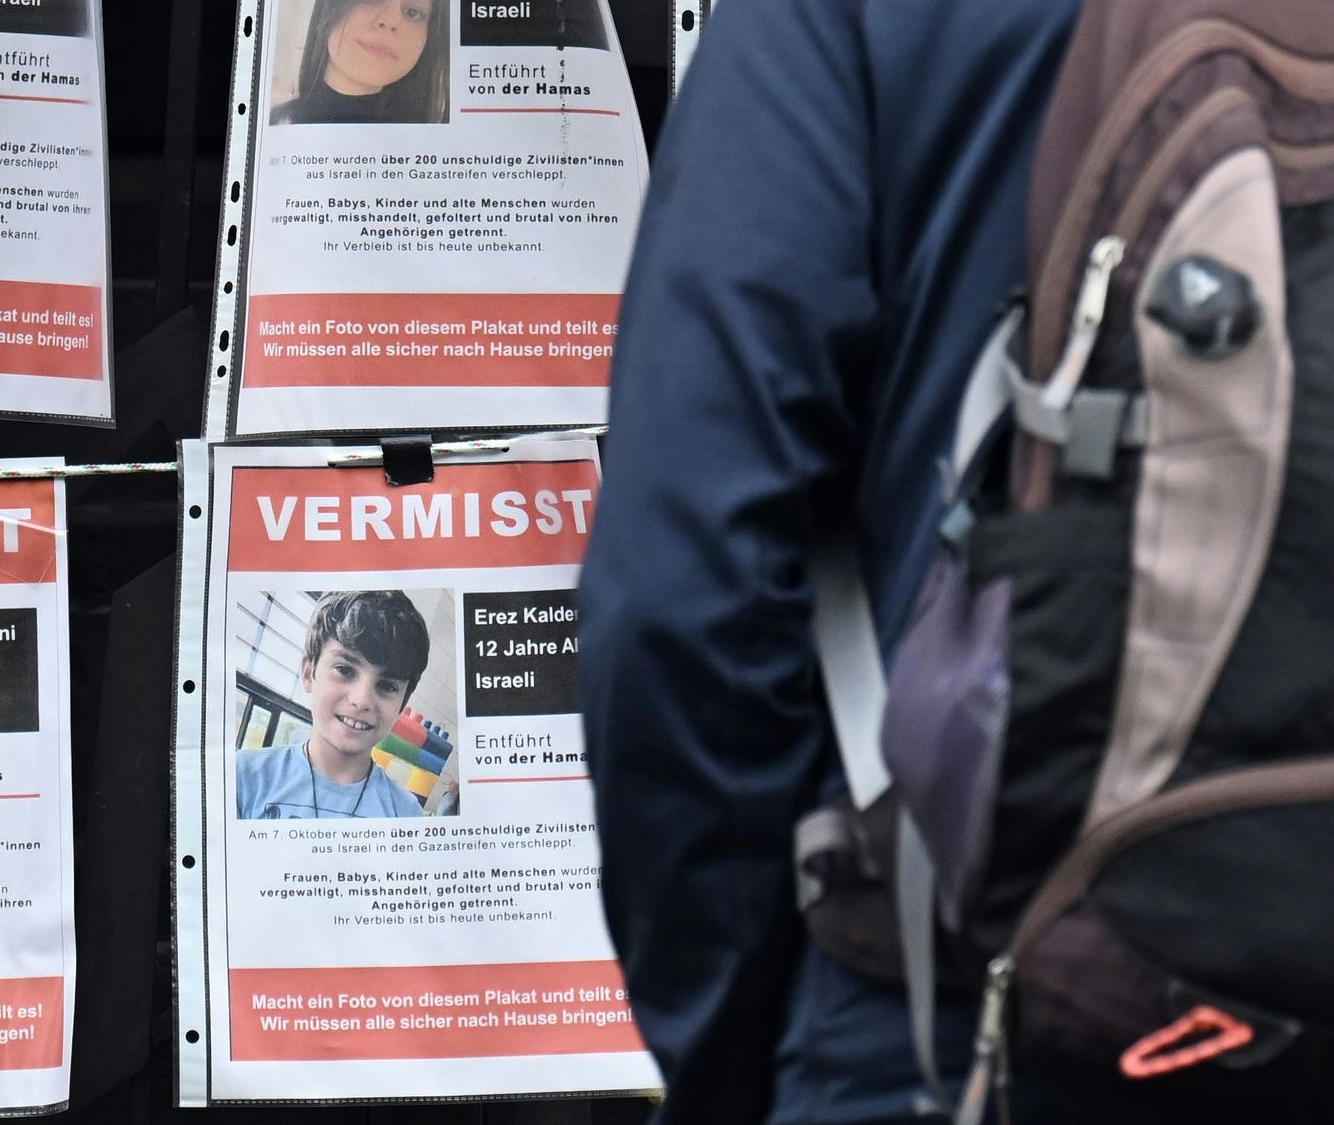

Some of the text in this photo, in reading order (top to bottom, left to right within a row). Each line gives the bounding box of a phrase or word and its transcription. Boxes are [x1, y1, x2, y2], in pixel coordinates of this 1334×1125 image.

[471, 1, 530, 18] Israeli
[468, 63, 546, 79] Entführt
[468, 82, 591, 96] von der Hamas
[256, 489, 593, 542] VERMISST
[474, 608, 518, 625] Erez
[475, 639, 498, 657] 12
[502, 638, 558, 657] Jahre
[475, 670, 535, 689] Israeli
[474, 733, 552, 749] Entführt
[16, 1002, 43, 1019] es!
